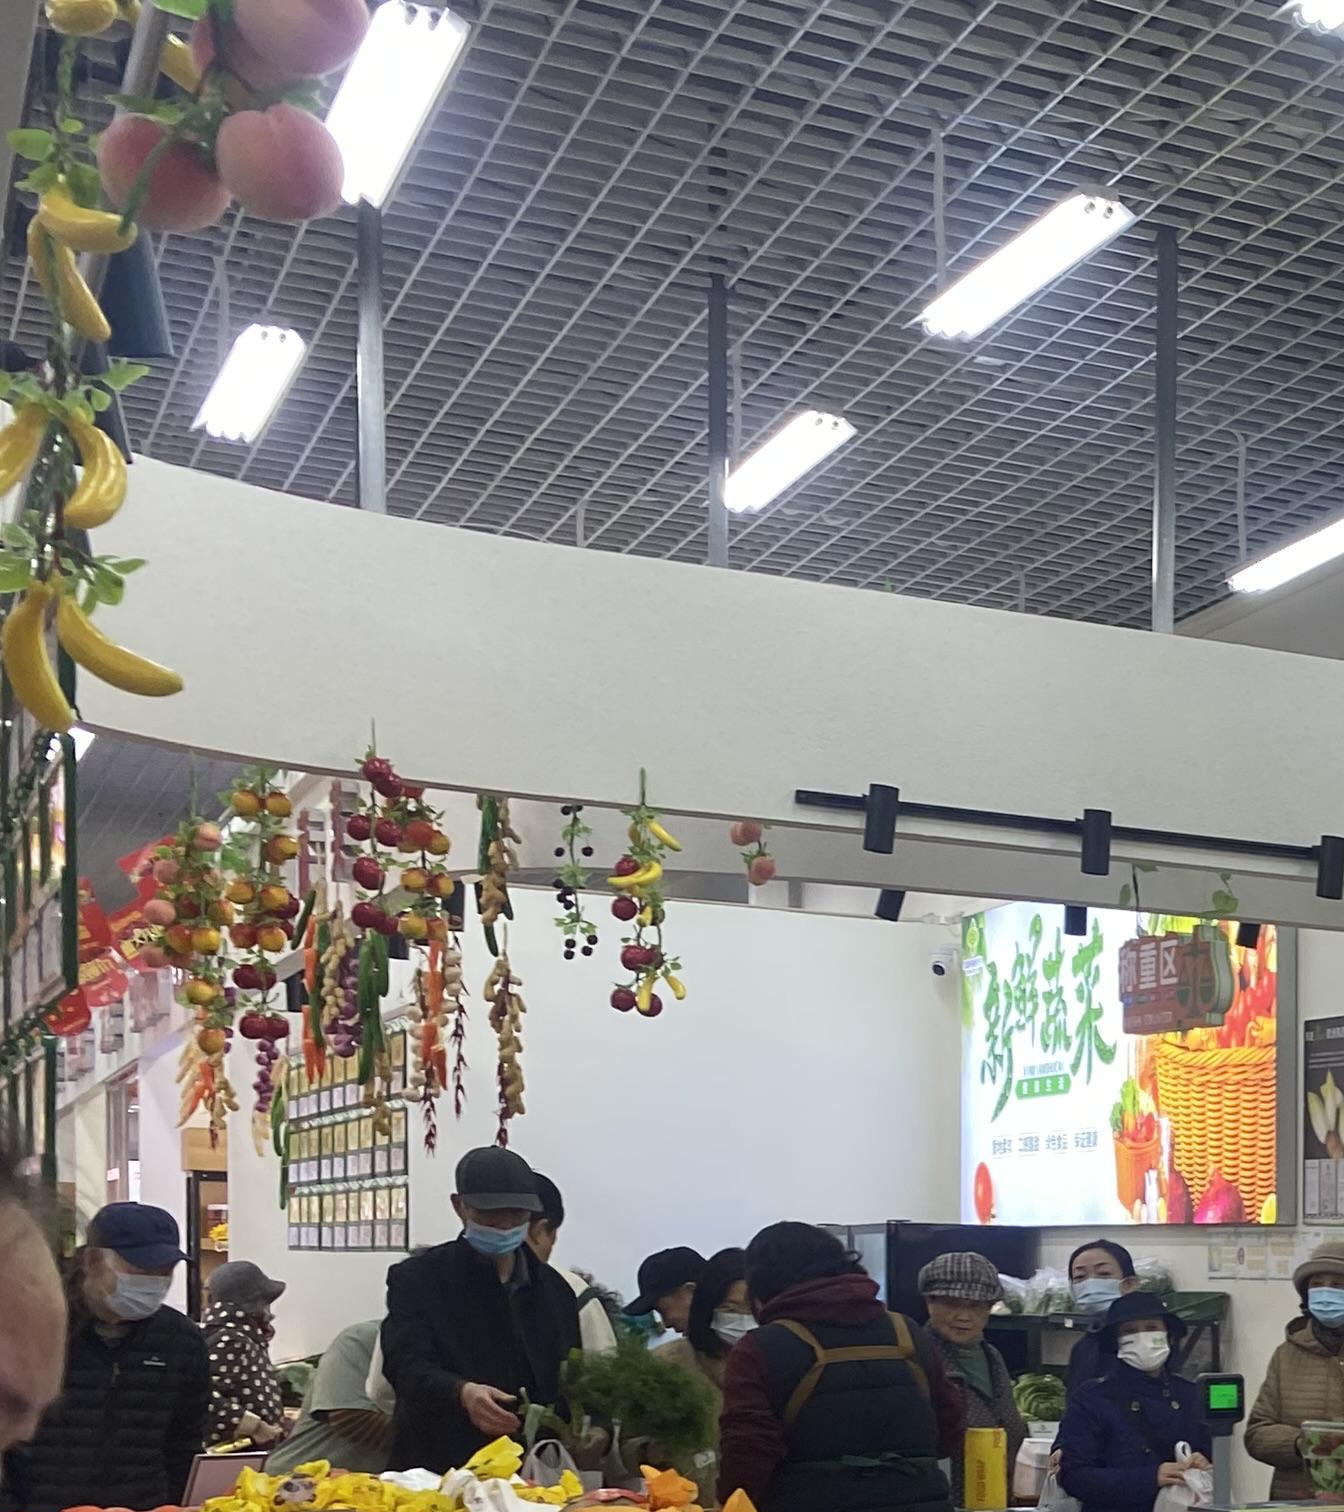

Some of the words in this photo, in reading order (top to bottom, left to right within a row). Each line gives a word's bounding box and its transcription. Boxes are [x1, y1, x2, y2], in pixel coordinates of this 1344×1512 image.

[980, 913, 1118, 1124] 新鲜蔬菜
[1118, 938, 1179, 993] 称重区
